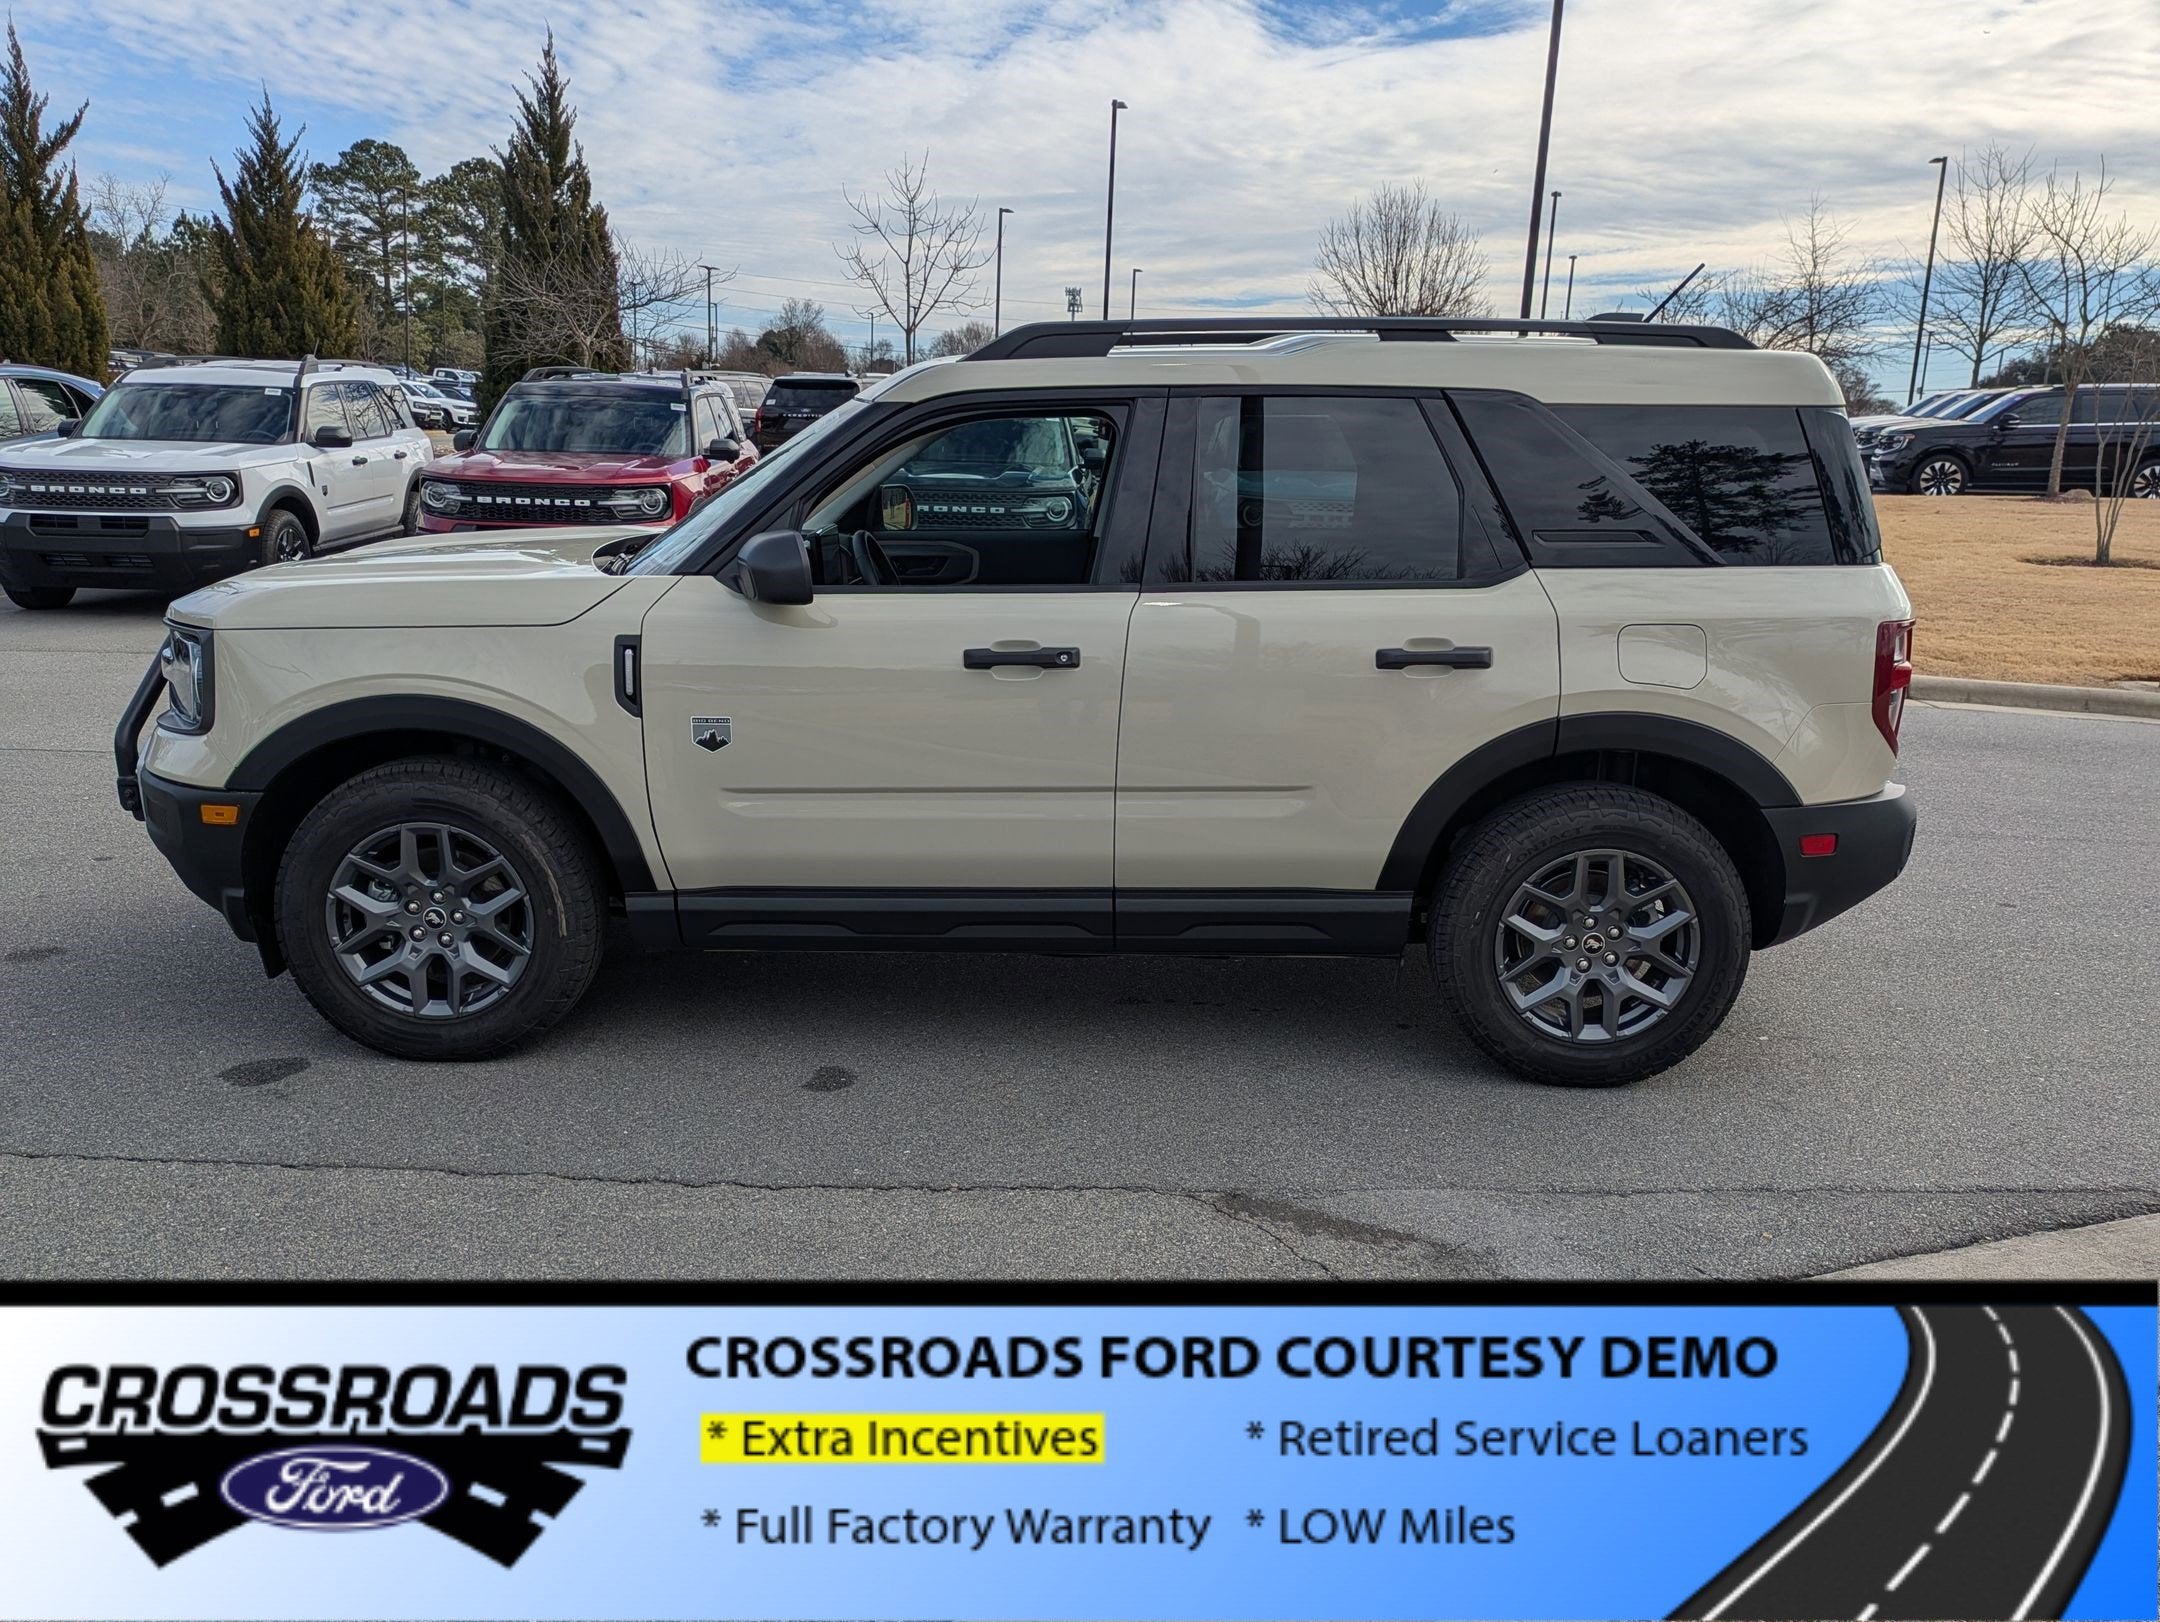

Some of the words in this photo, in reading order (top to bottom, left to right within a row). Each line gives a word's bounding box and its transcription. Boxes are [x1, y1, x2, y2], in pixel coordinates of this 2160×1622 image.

[30, 485, 147, 494] BRONCO
[476, 496, 591, 506] BRONCO
[917, 505, 1005, 513] RONCO
